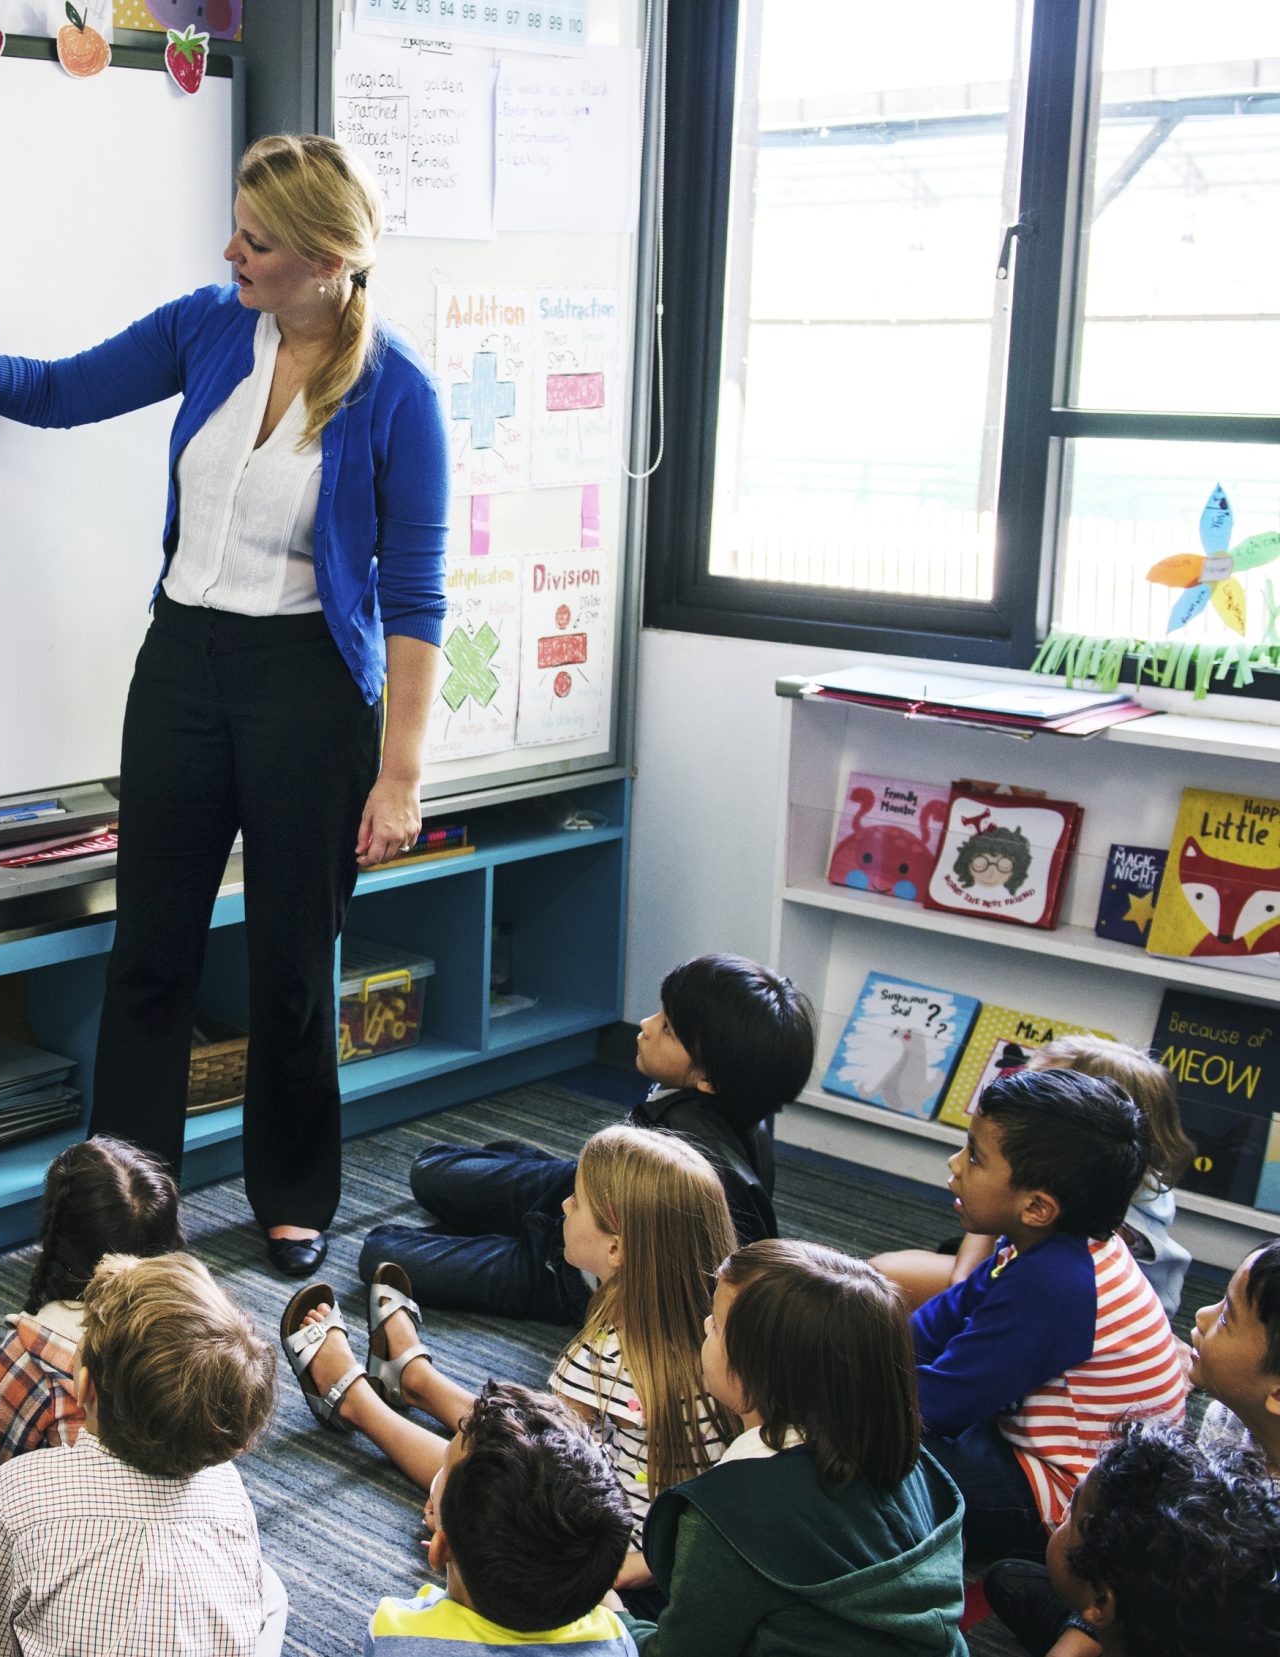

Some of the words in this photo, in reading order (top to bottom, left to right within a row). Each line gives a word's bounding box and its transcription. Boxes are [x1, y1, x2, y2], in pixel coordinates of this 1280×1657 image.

[416, 0, 431, 14] 93
[439, 1, 454, 16] 94
[462, 3, 477, 20] 95
[484, 7, 498, 22] 96
[506, 11, 520, 26] 97
[528, 13, 541, 28] 98
[548, 16, 563, 30] 99
[345, 66, 403, 96] magical
[446, 295, 525, 328] Addition
[539, 297, 616, 321] Subtraction
[446, 566, 514, 590] ultiplication
[532, 563, 600, 594] Division
[881, 801, 916, 816] Monster
[884, 786, 918, 805] Friendly
[1243, 798, 1280, 822] Happ
[1200, 810, 1270, 846] Little
[1113, 851, 1156, 870] MAGIC
[1114, 865, 1159, 885] NIGHT
[1169, 1010, 1240, 1045] Because
[1247, 1027, 1273, 1048] of
[1159, 1044, 1262, 1100] MEOW
